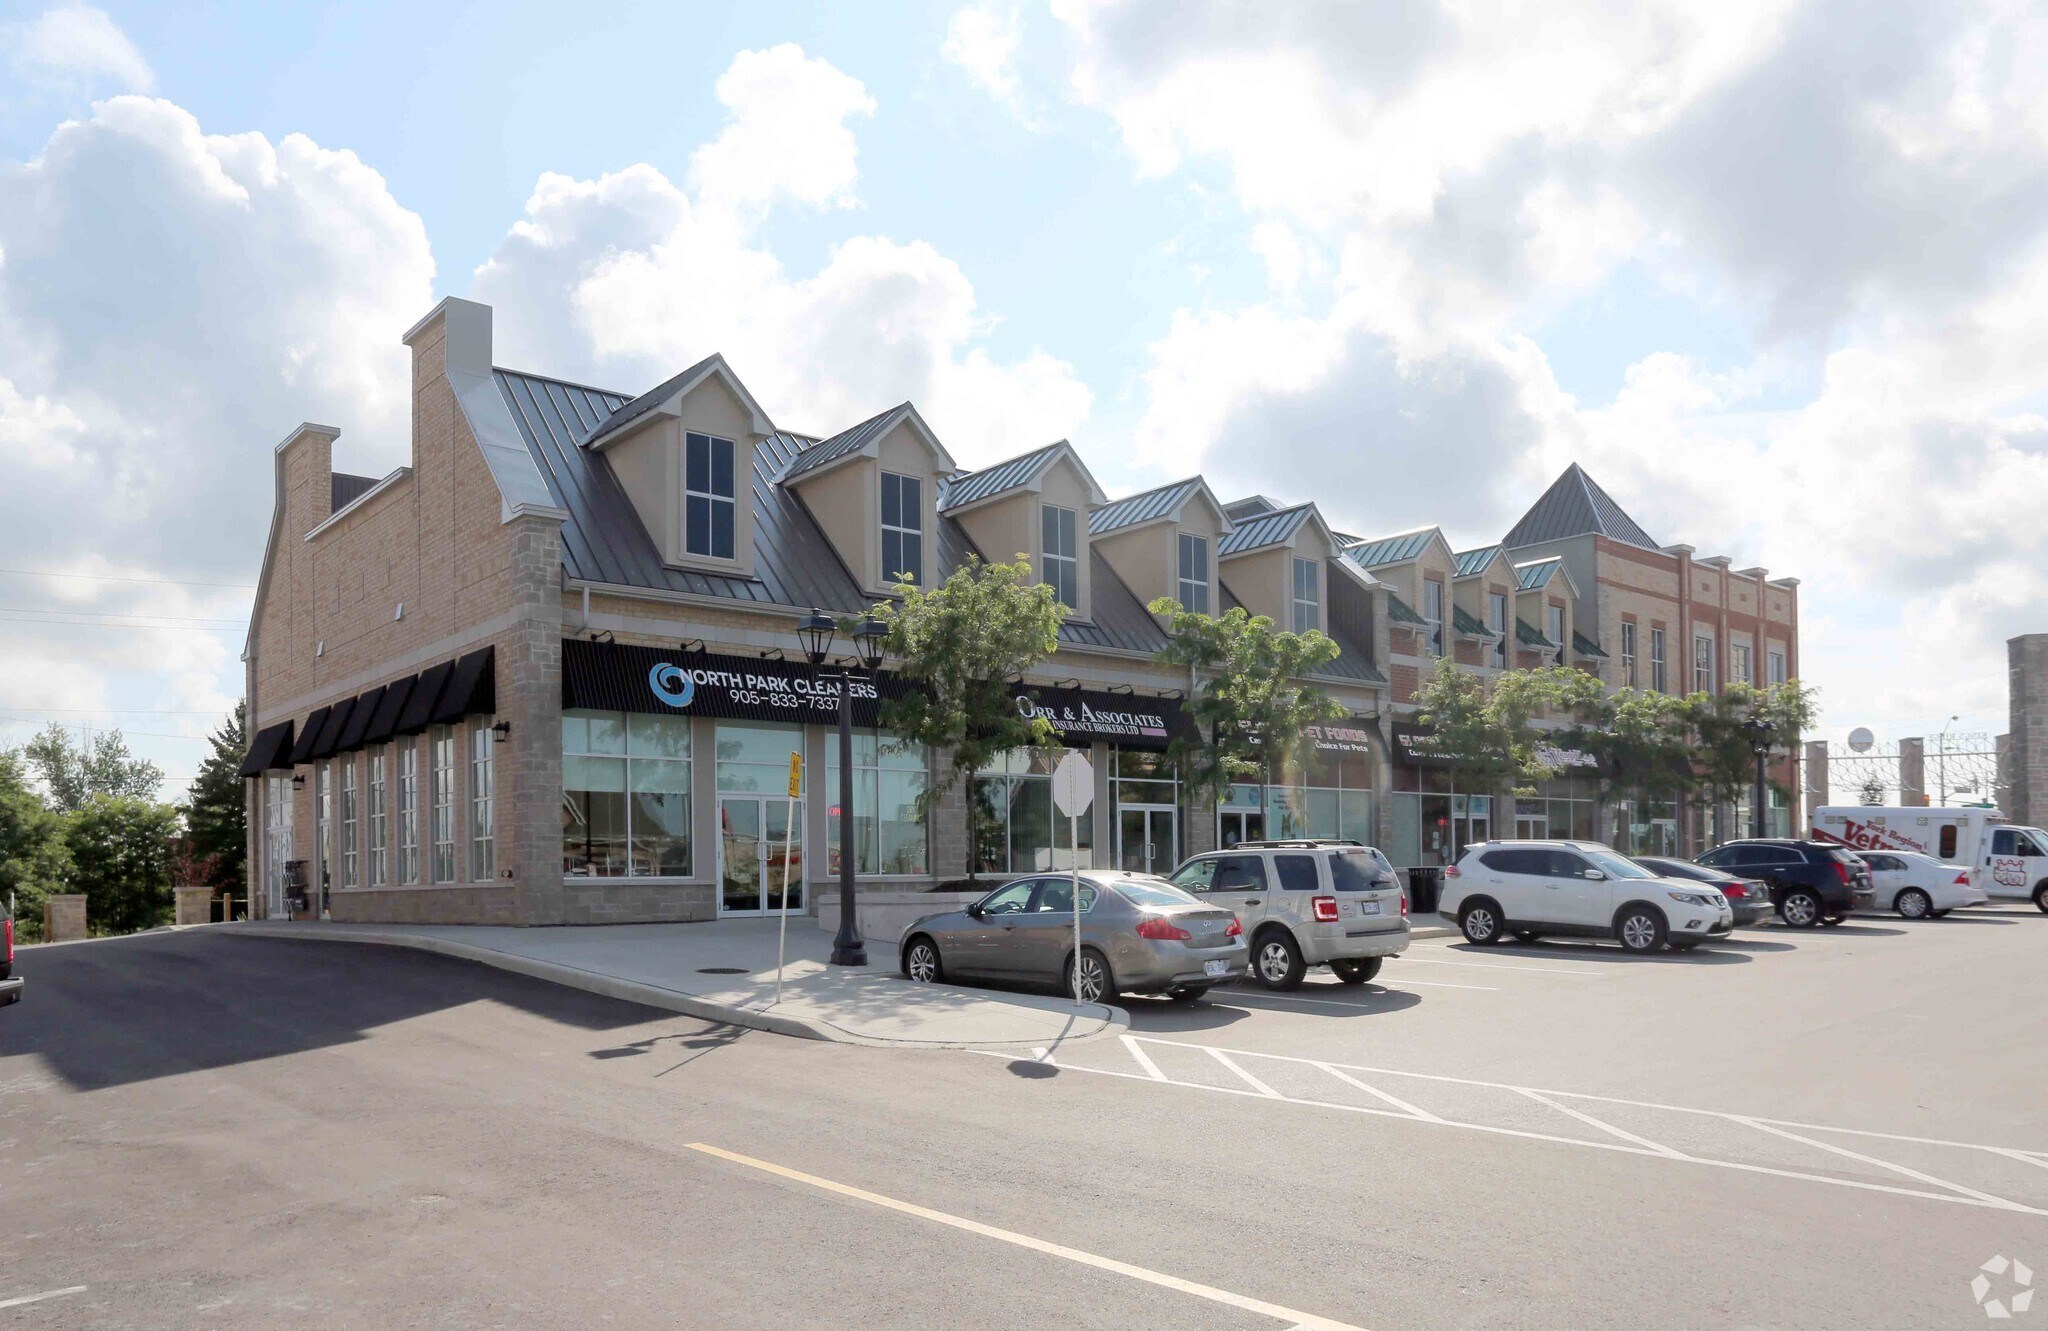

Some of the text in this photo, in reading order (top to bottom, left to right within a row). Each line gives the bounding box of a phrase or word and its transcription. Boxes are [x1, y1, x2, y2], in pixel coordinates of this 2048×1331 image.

[680, 669, 743, 688] NORTH
[746, 674, 791, 693] PARK
[730, 690, 840, 710] 905-833-7337
[1064, 706, 1076, 720] &
[1052, 720, 1139, 735] INSURANCE BROKERS LTD
[1324, 726, 1368, 743] FOODS
[1315, 740, 1368, 752] Choice For Pets
[1865, 819, 1922, 850] York Region
